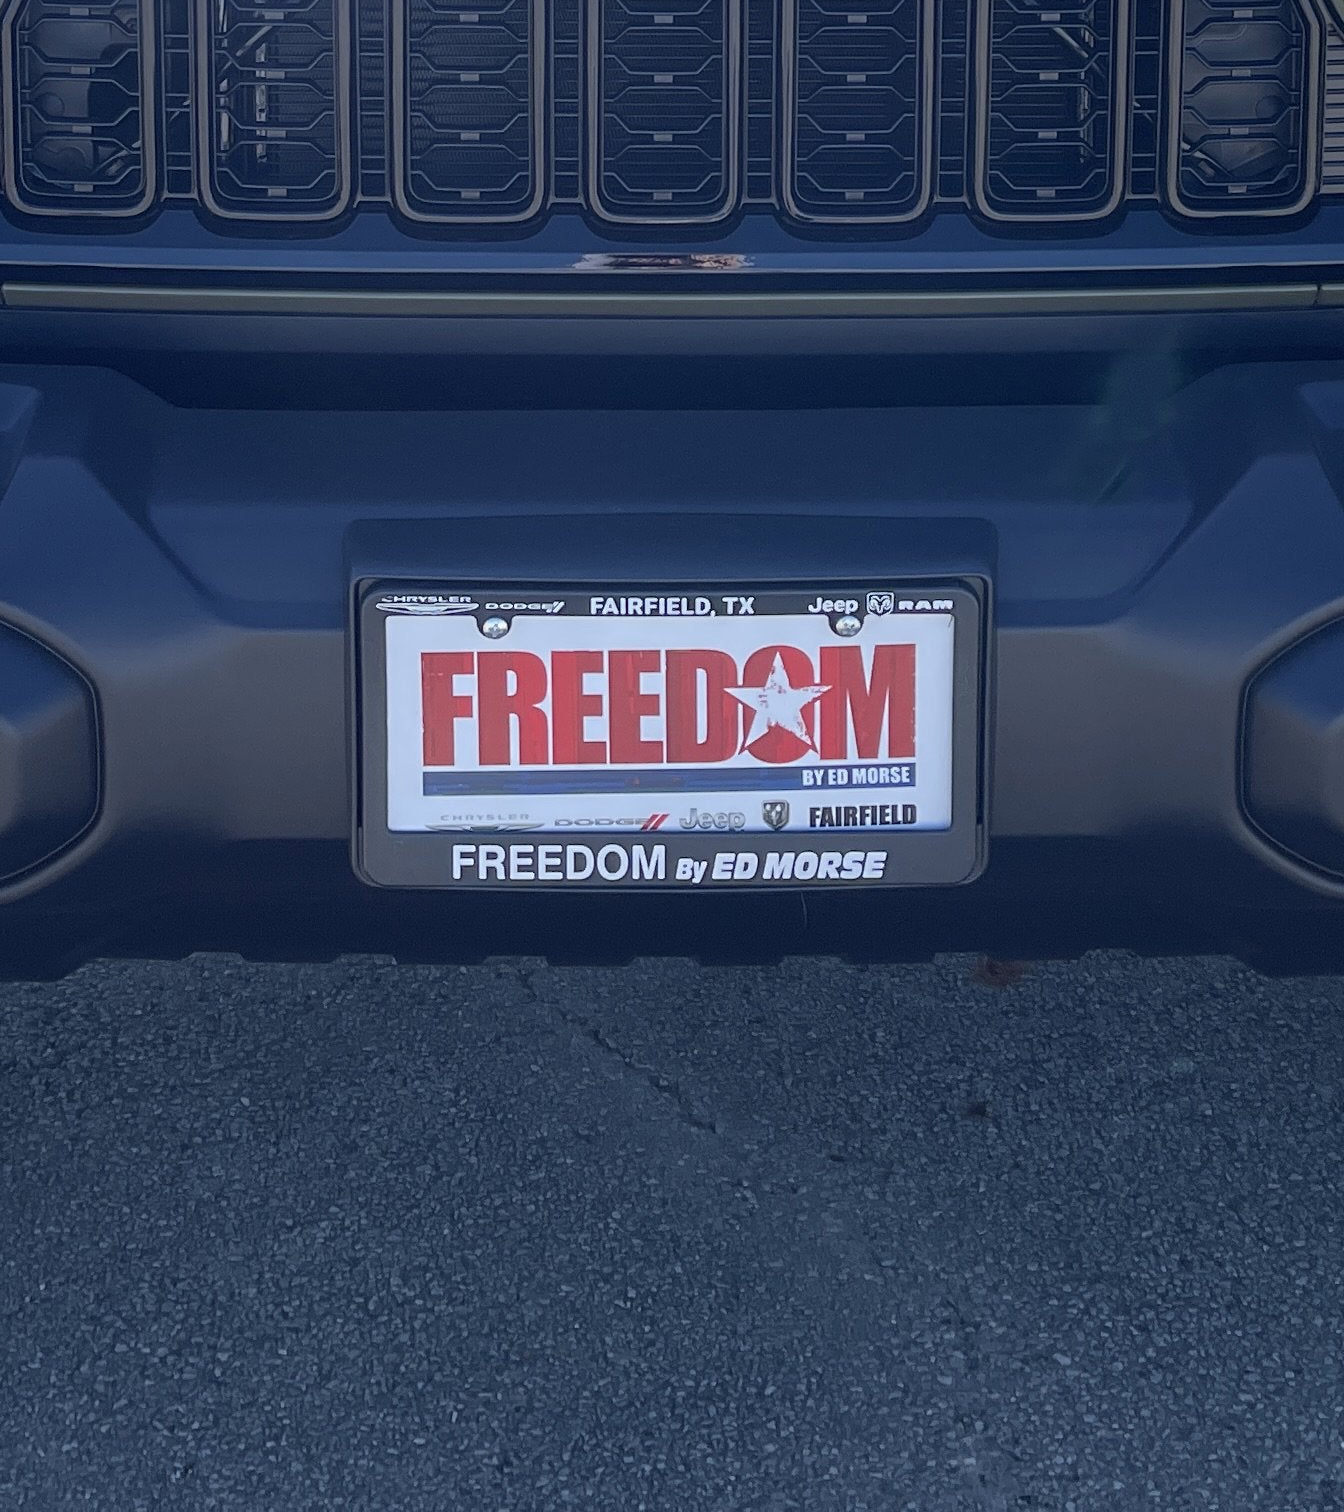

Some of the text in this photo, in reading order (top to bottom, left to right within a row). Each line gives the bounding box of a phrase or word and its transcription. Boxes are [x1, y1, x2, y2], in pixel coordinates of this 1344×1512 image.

[381, 595, 472, 603] CHRYSLER
[589, 596, 755, 618] FAIRFIELD, TX
[807, 596, 859, 614] Jeep
[898, 599, 954, 611] RAM
[420, 643, 917, 767] FREEDOM
[802, 766, 911, 787] BY ED MORSE
[440, 813, 530, 821] CHRYSLER
[679, 807, 746, 831] Jeep
[809, 803, 917, 828] FAIRFIELD
[452, 844, 888, 884] FREEDOM By ED MORSE
